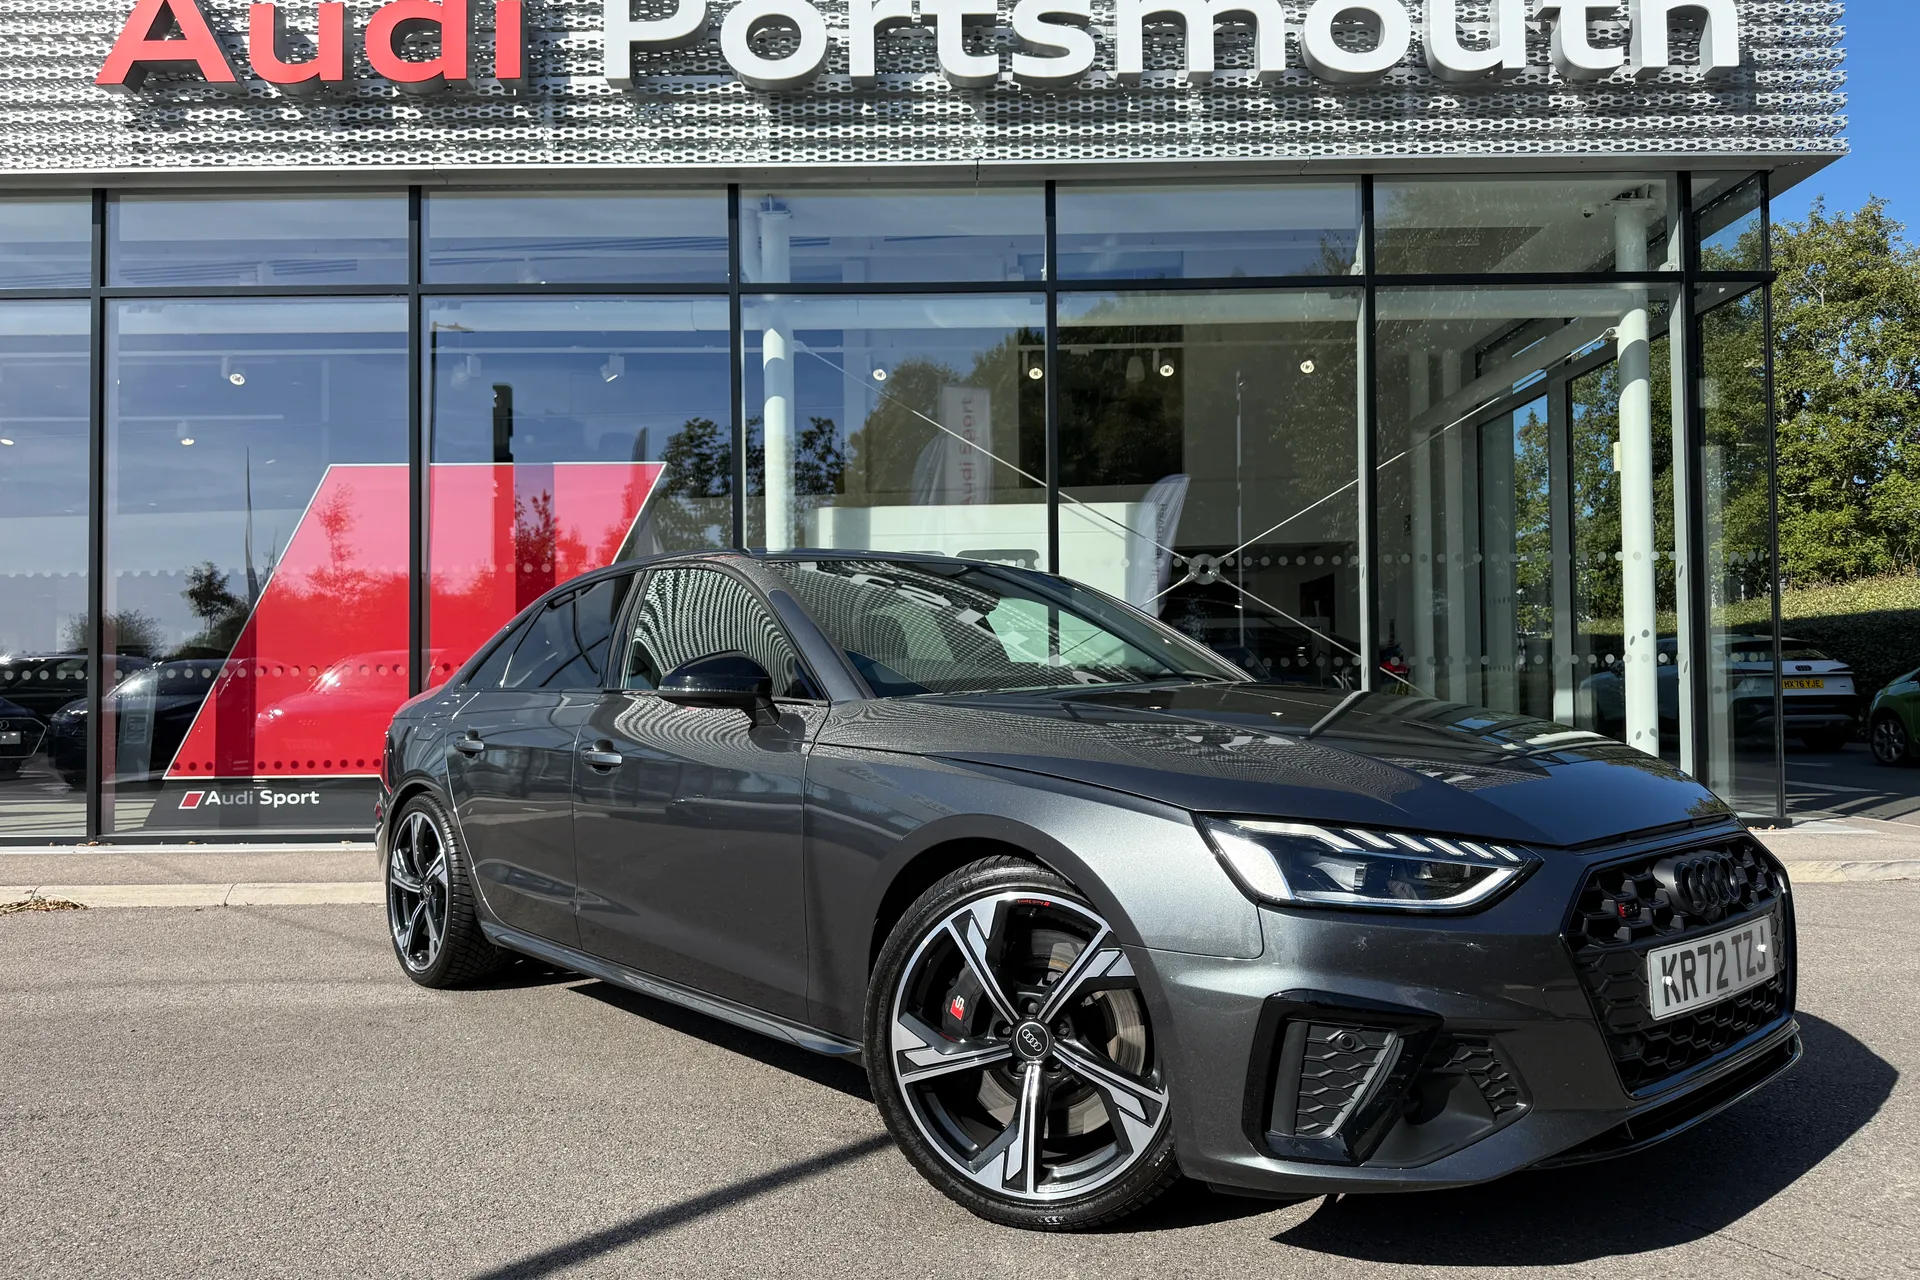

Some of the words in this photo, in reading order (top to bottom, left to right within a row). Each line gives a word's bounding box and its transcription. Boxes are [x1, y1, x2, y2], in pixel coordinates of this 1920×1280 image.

[94, 0, 522, 84] Audi
[603, 0, 1740, 84] Portsmouth
[959, 397, 976, 455] Sport
[205, 790, 254, 806] Audi
[259, 790, 320, 808] Sport
[1661, 941, 1729, 1006] KR72
[1731, 925, 1767, 982] TZJ
